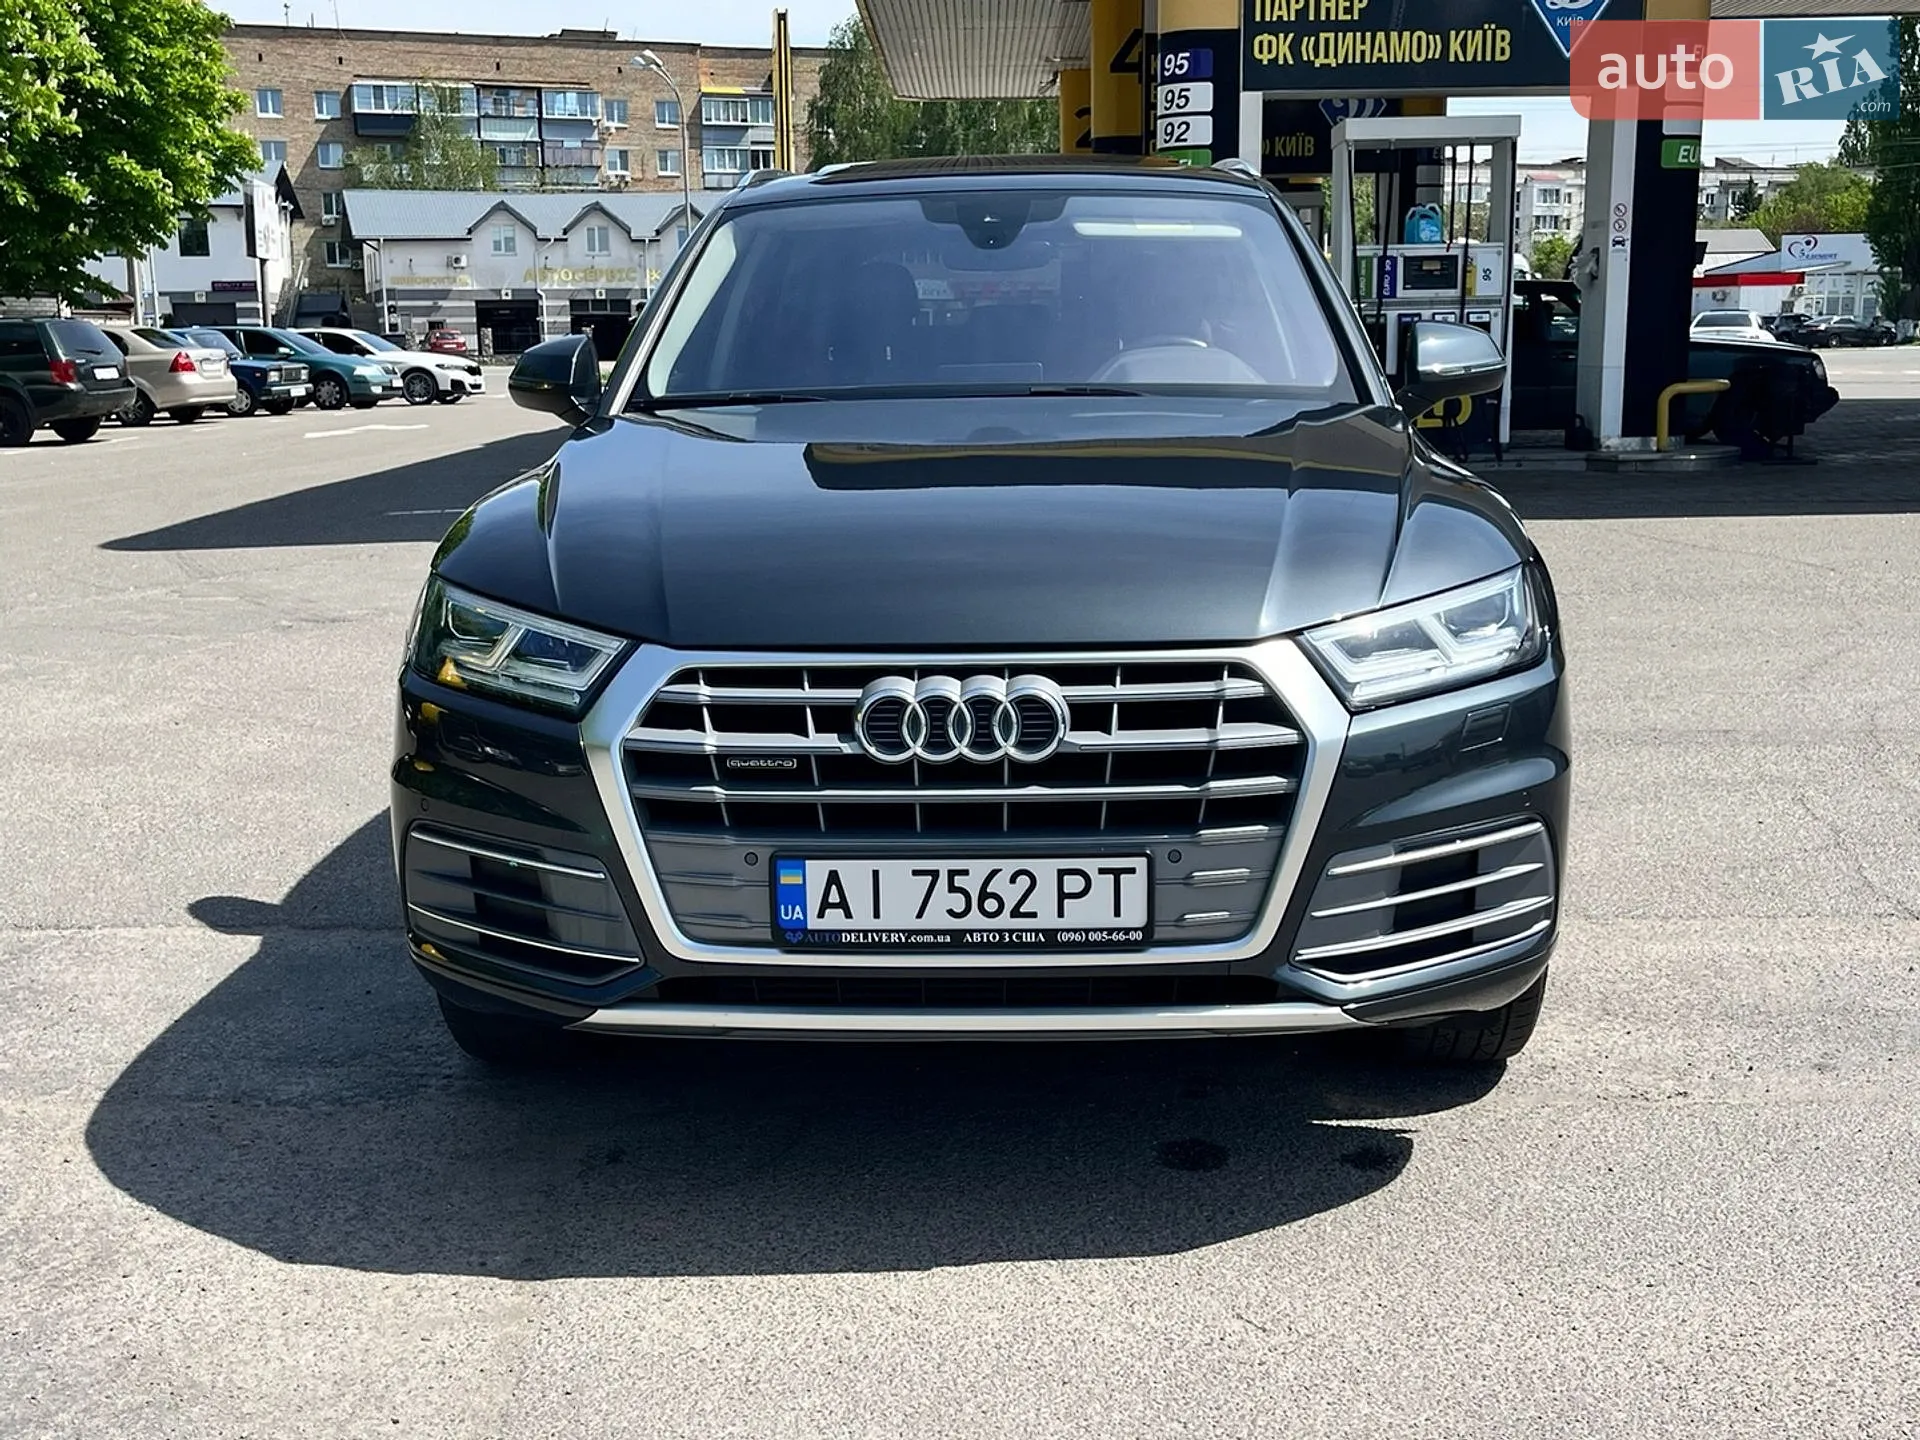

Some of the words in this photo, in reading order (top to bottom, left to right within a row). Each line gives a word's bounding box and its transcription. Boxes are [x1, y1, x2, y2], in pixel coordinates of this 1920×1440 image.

[1254, 0, 1368, 22] ПАРТНЕР
[1253, 32, 1295, 65] ФК
[1301, 30, 1443, 67] «ДИНАМО»
[1448, 24, 1512, 63] КИЇВ
[1163, 52, 1190, 76] 95
[1163, 88, 1191, 111] 95
[1163, 121, 1191, 143] 92
[1274, 133, 1315, 158] КИЇВ
[1482, 267, 1493, 282] 95
[730, 758, 793, 767] quattro
[816, 869, 881, 919] AI
[911, 868, 1038, 919] 7562
[1056, 867, 1137, 918] PT
[781, 905, 804, 920] UA
[806, 932, 951, 943] AUTODELIVERY.com.ua
[963, 932, 999, 942] АВТО
[1012, 931, 1046, 942] США
[1057, 931, 1086, 943] (096)
[1088, 930, 1143, 942] 005-66-00
